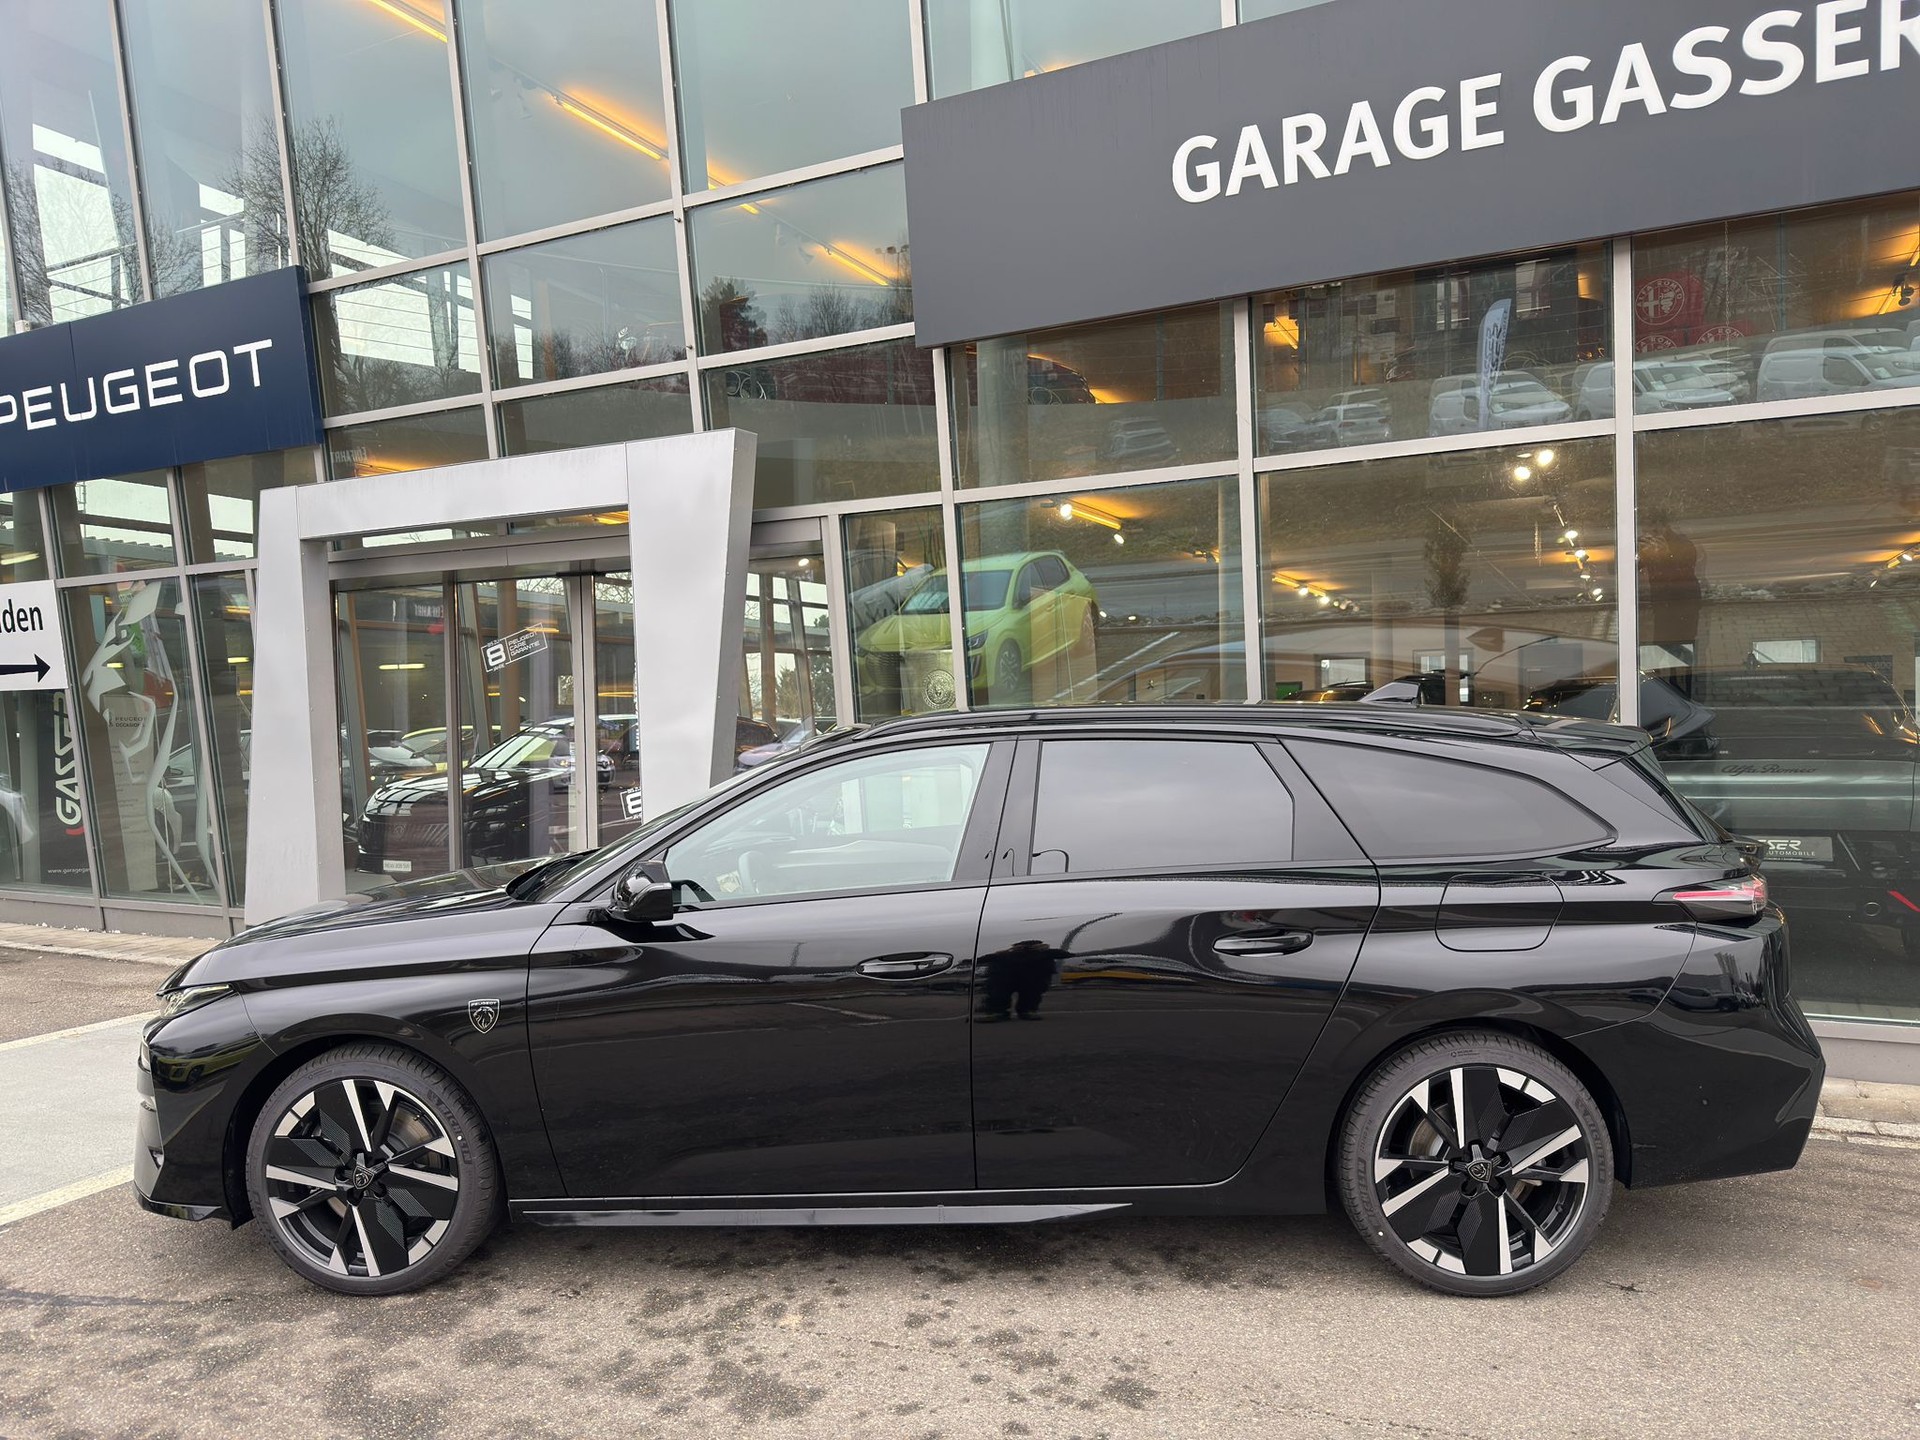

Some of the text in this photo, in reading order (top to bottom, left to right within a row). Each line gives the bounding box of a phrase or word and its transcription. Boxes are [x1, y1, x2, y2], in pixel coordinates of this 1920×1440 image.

[1172, 0, 1920, 203] GARAGE GASSER
[0, 339, 273, 430] PEUGEOT
[0, 599, 43, 633] den
[508, 631, 538, 646] PEUGEOT
[509, 641, 526, 652] CARE
[511, 641, 541, 657] GARANTIE
[486, 643, 506, 667] 8
